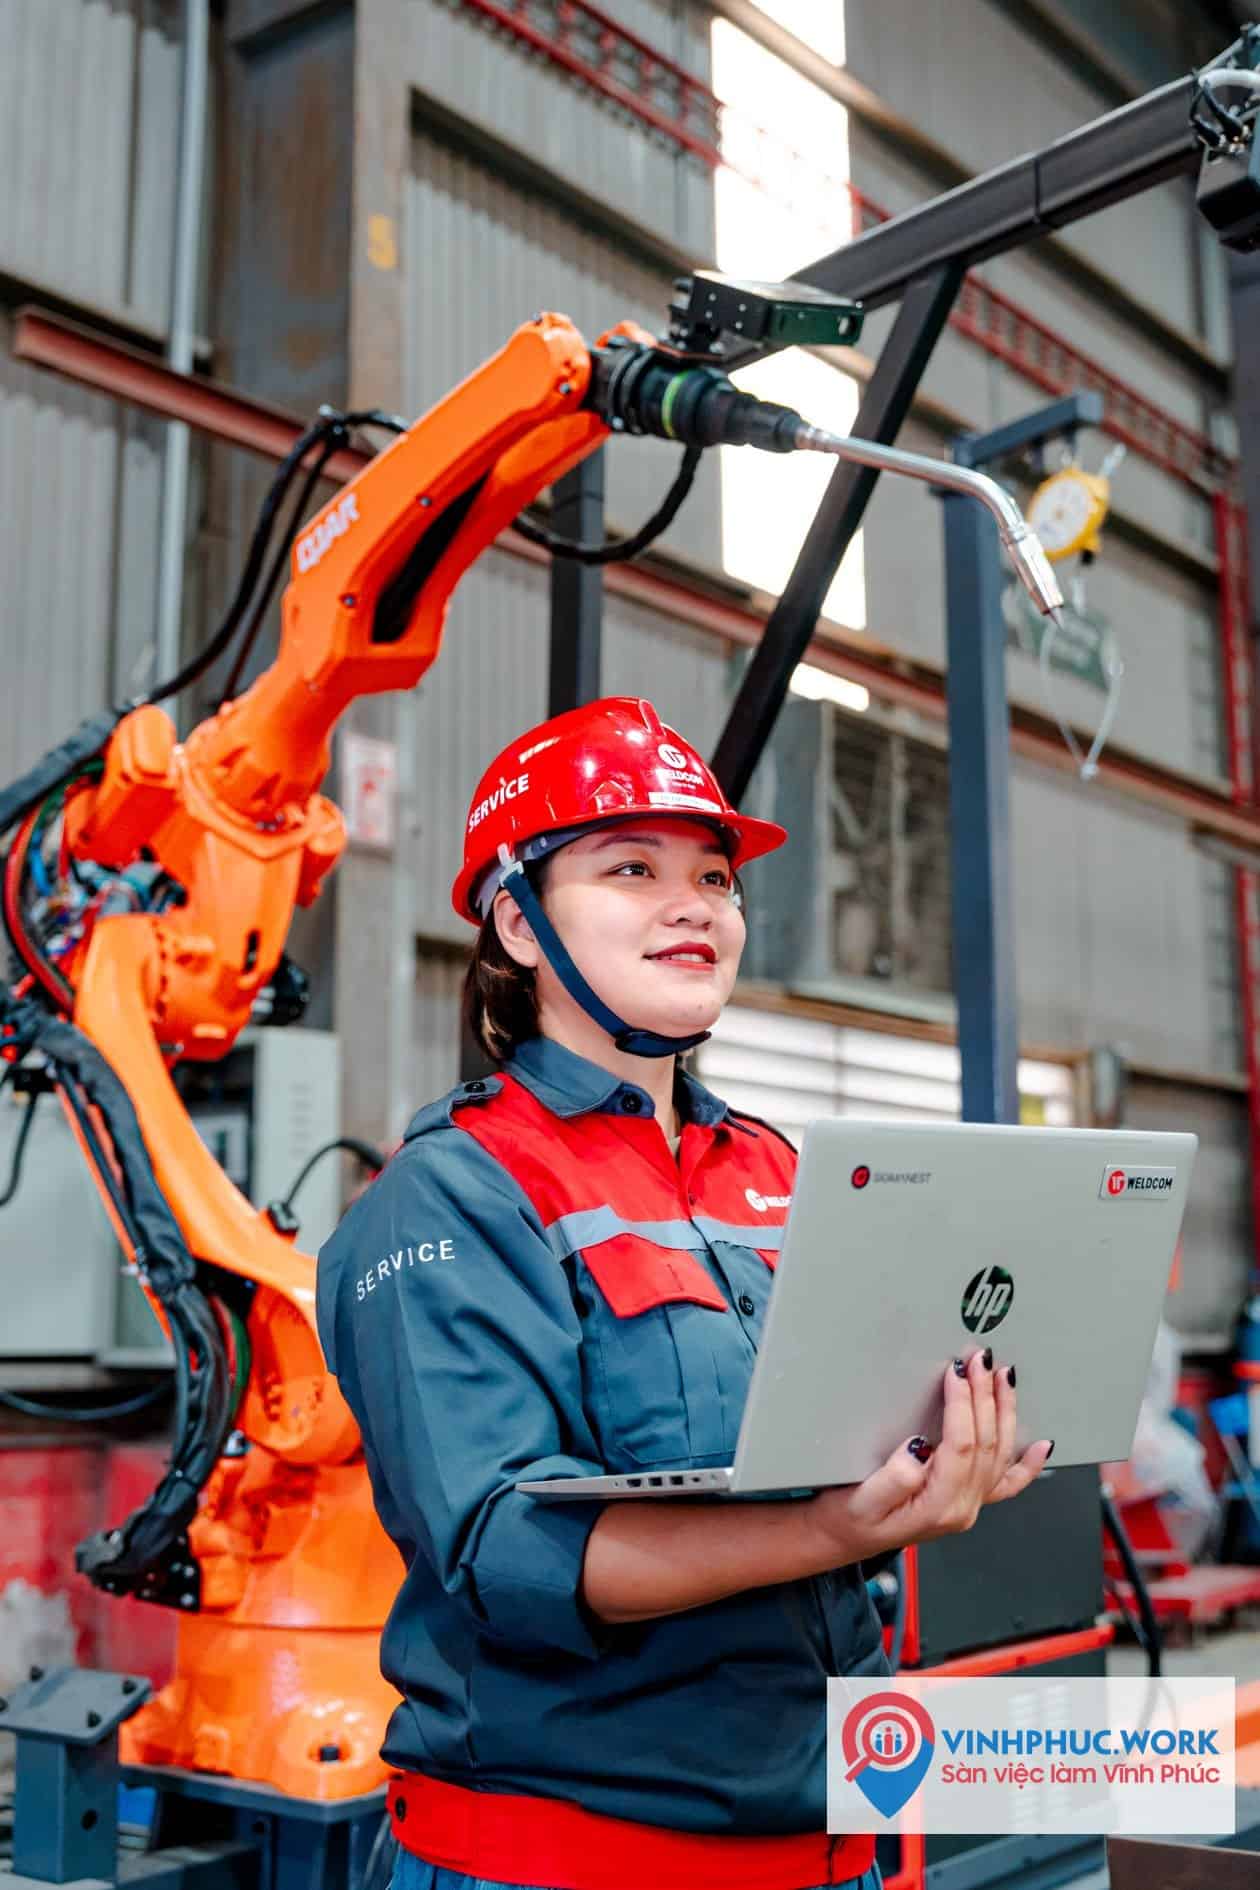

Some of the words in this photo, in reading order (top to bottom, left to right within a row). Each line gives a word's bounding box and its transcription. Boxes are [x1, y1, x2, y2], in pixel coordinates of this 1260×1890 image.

[468, 773, 529, 833] SERVICE
[1127, 1177, 1173, 1190] WELDCOM
[356, 1239, 455, 1301] SERVICE
[963, 1265, 1012, 1333] hp
